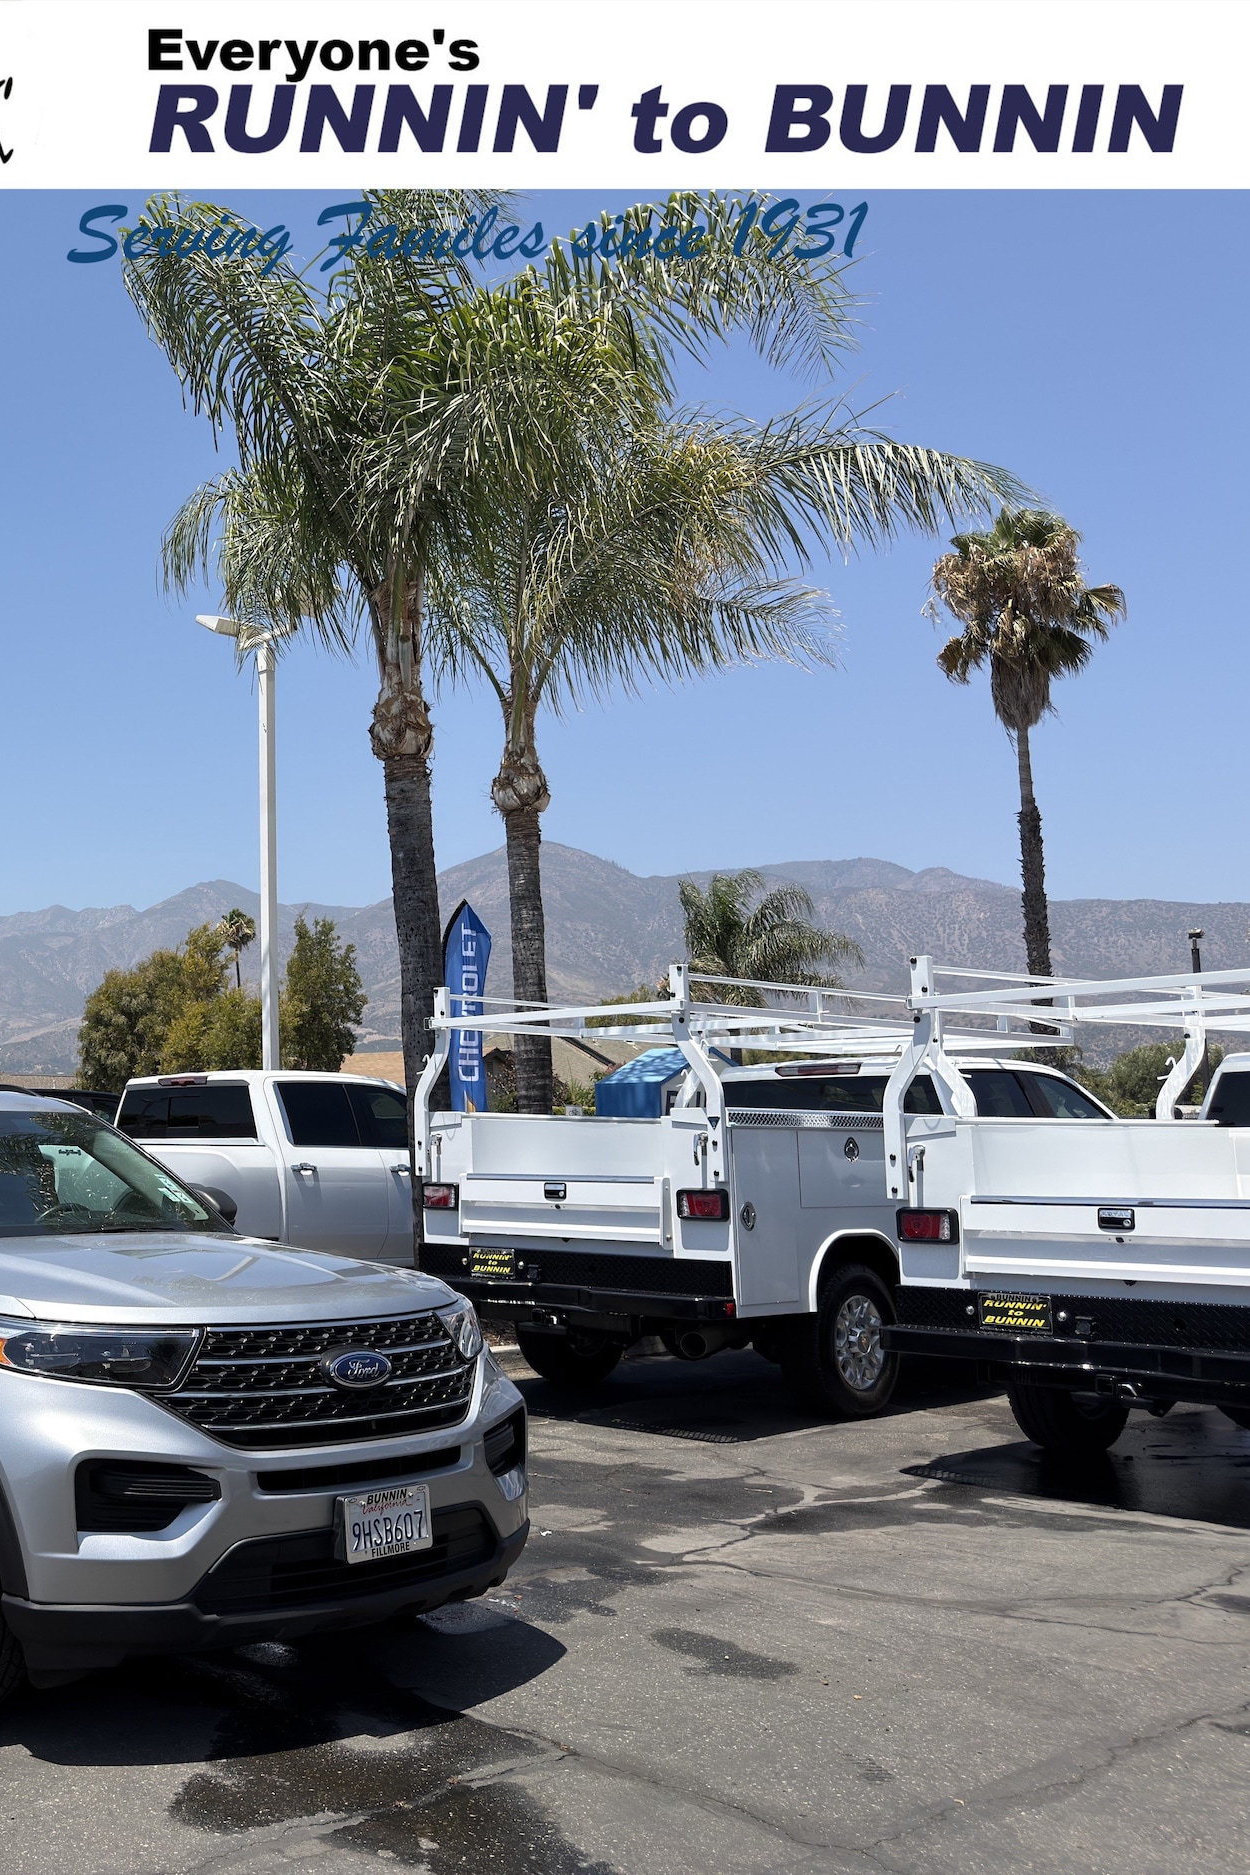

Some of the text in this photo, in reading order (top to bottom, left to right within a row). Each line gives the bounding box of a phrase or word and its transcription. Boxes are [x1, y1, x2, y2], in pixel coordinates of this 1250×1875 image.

[458, 922, 479, 1082] CHEROLET
[473, 1265, 511, 1274] BUNNIN
[983, 1299, 1048, 1311] RUNNIN'
[984, 1315, 1046, 1327] BUNNIN
[347, 1359, 380, 1380] Ford
[366, 1488, 408, 1505] BUNNIN
[362, 1499, 412, 1516] California
[352, 1510, 424, 1550] 9HSB607
[371, 1542, 410, 1558] FILLMORE
